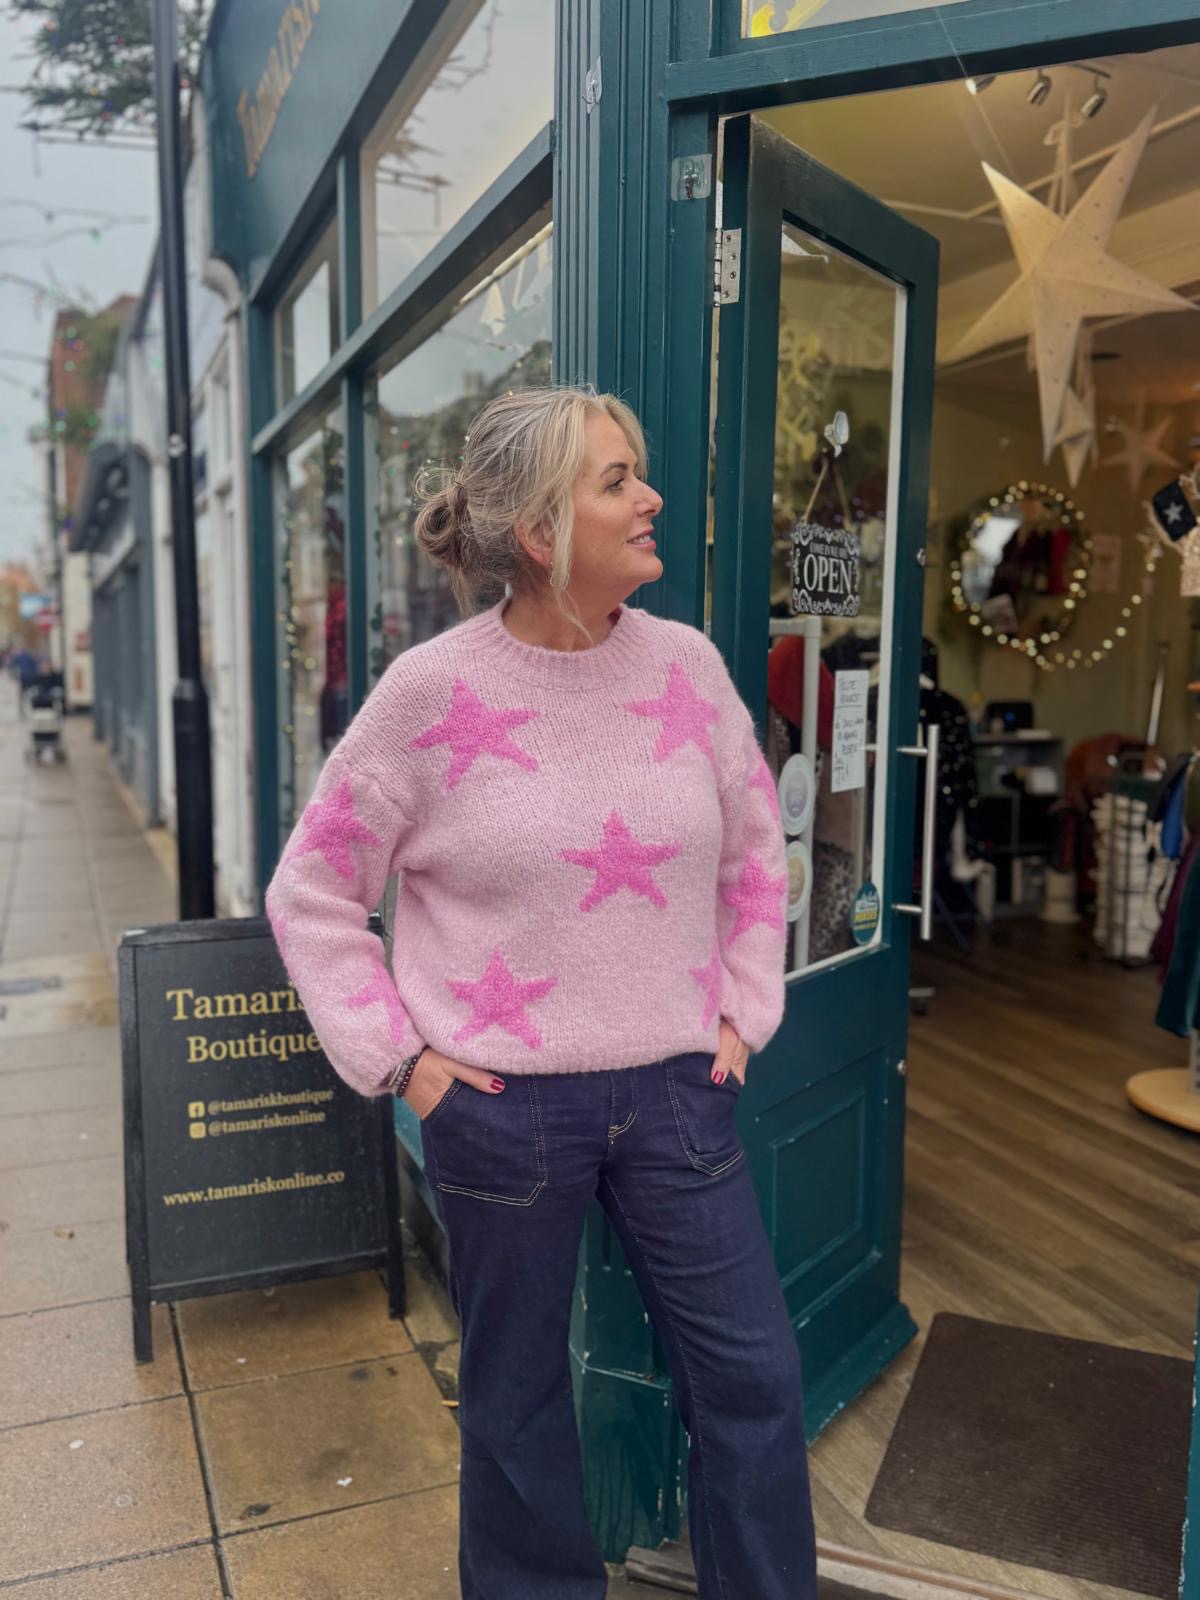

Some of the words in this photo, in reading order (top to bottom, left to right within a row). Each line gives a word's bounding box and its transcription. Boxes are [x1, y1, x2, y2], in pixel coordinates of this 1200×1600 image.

[803, 553, 853, 595] OPEN
[166, 980, 304, 1020] Tamari
[186, 1028, 321, 1063] Boutique
[207, 1088, 334, 1115] @tamariskboutique
[207, 1110, 326, 1137] @tamariskonline
[163, 1169, 345, 1206] www.tamariskonline.co
